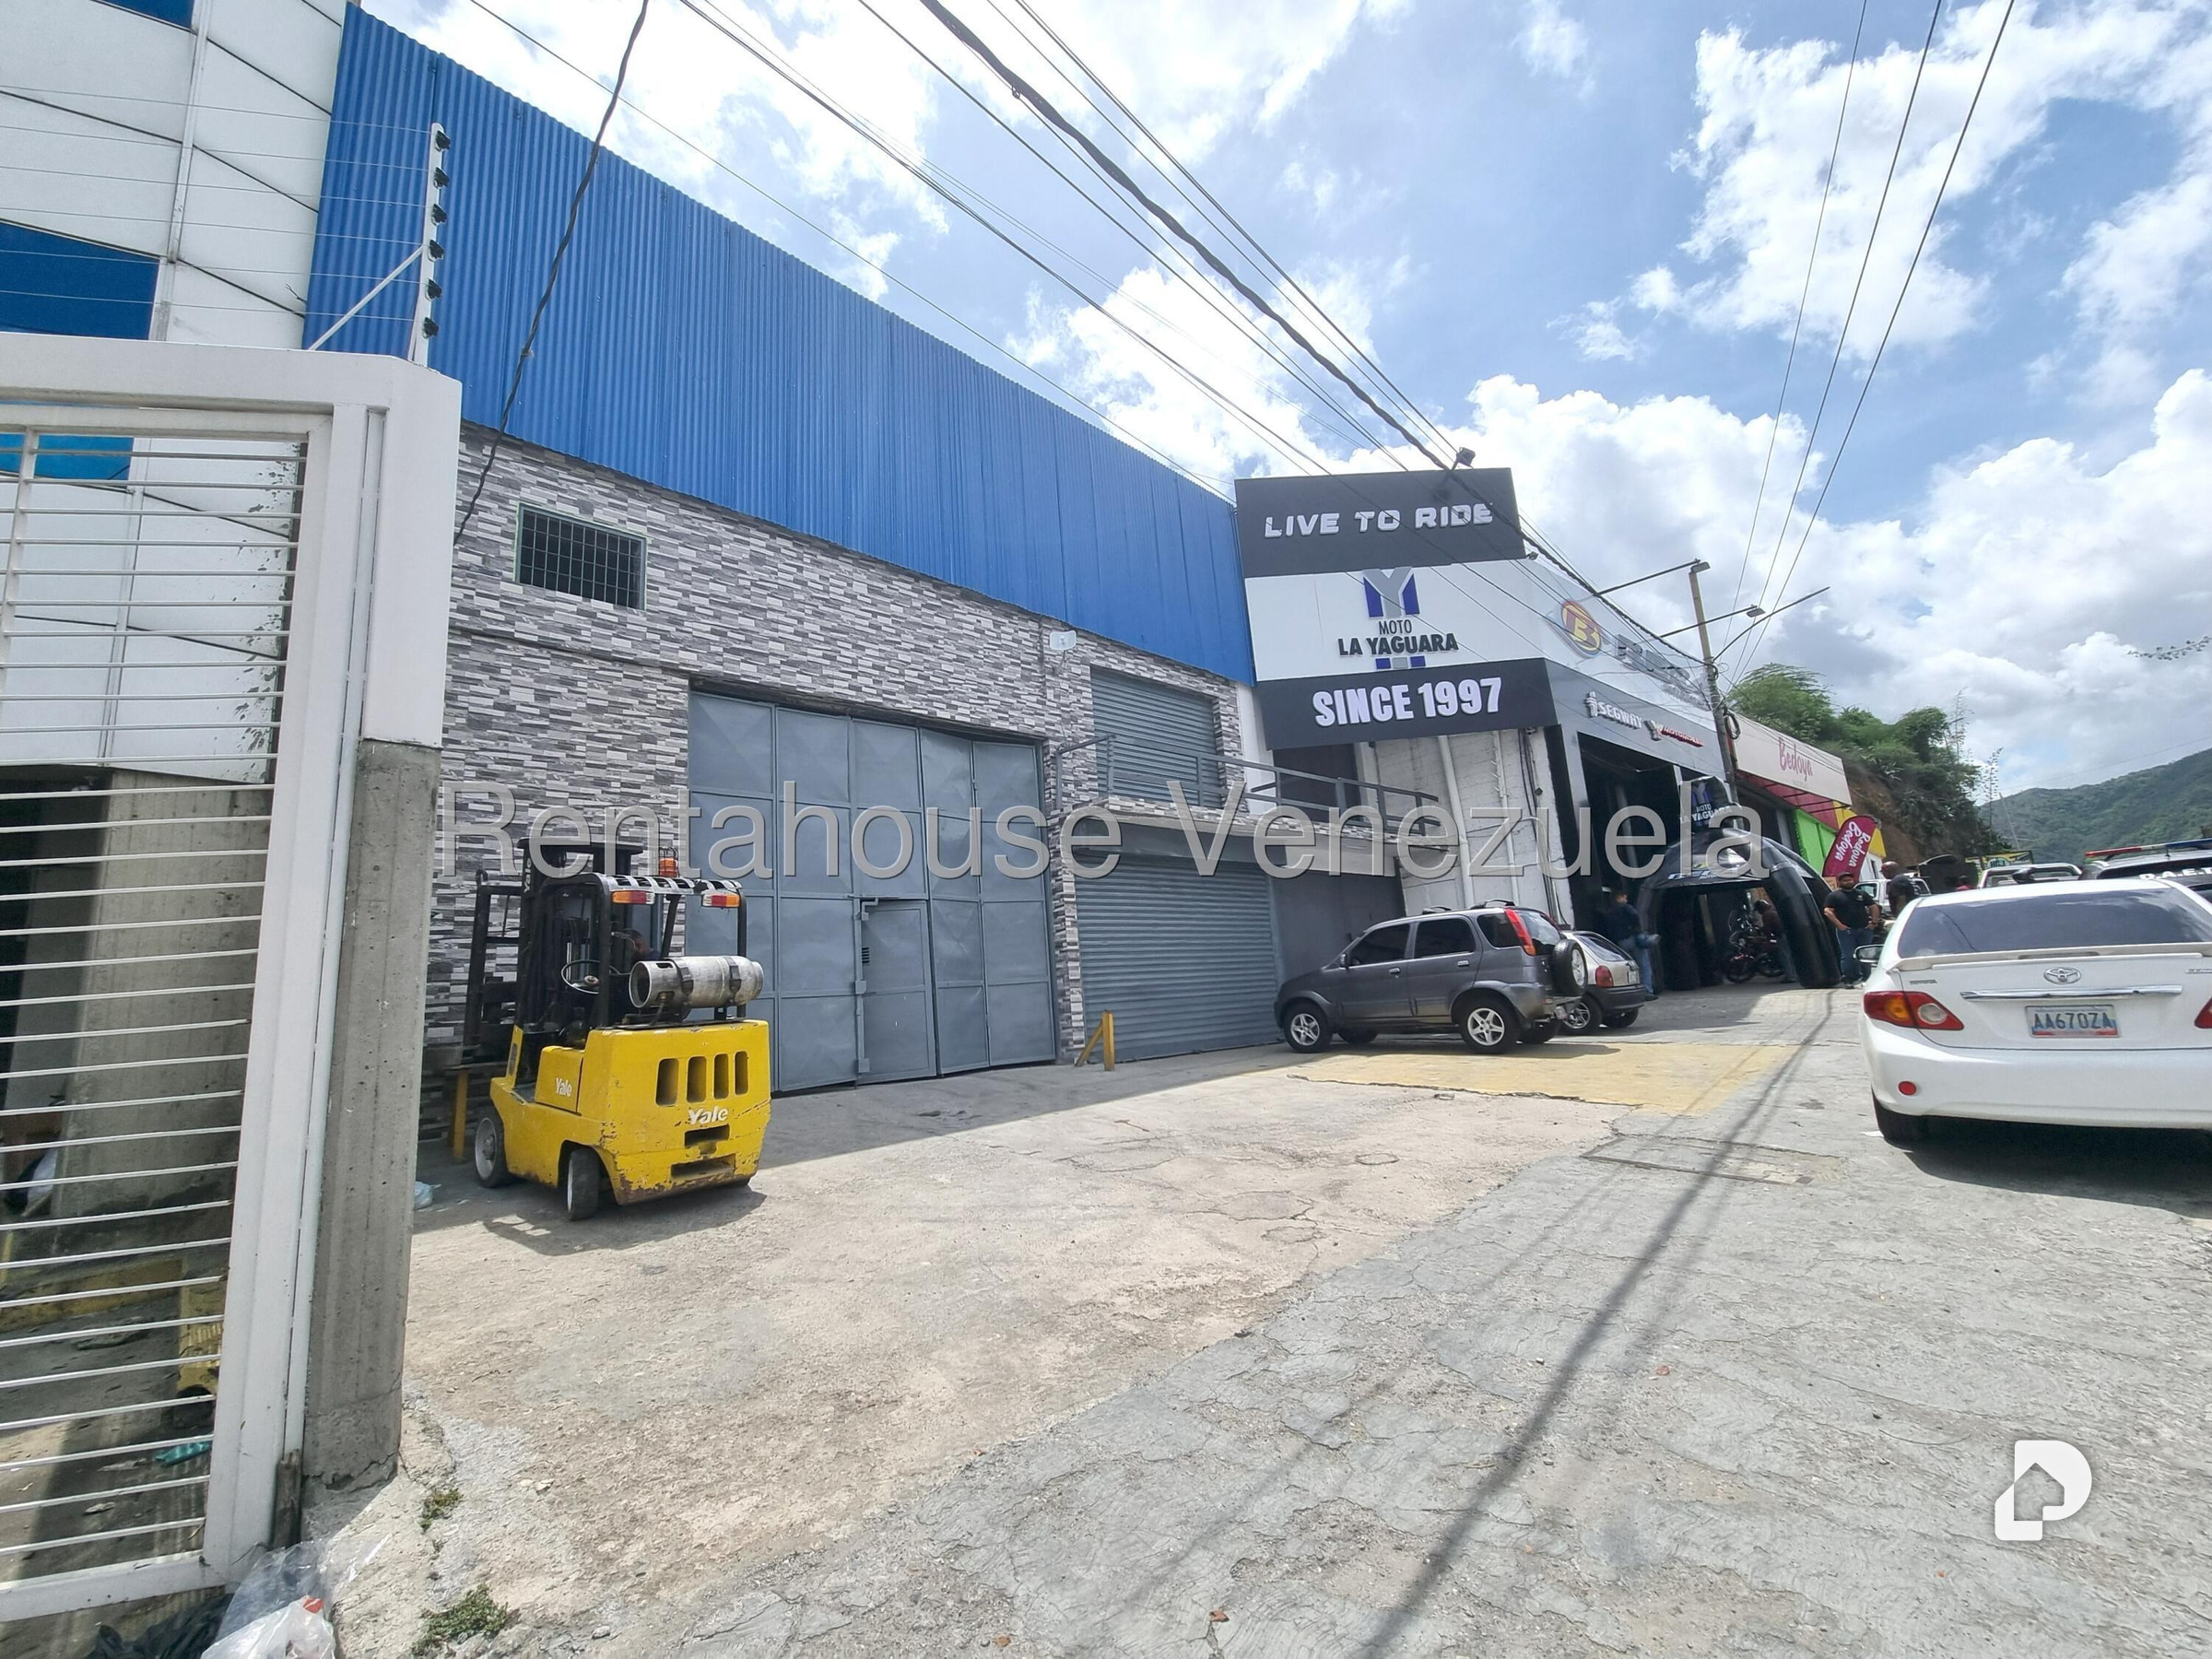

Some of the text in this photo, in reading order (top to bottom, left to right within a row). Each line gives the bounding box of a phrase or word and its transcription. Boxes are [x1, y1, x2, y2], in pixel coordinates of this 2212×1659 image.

[1265, 503, 1494, 537] LIVE TO RIDE
[1378, 619, 1413, 635] MOTO
[1338, 632, 1460, 656] LA YAGUARA
[1312, 677, 1502, 727] SINCE 1997
[1596, 701, 1642, 730] SEGWAY
[1778, 736, 1814, 782] Bedoya
[524, 857, 532, 893] Yale
[2033, 1011, 2113, 1030] AA670ZA
[556, 1077, 572, 1098] Yale
[688, 1106, 728, 1124] Yale
